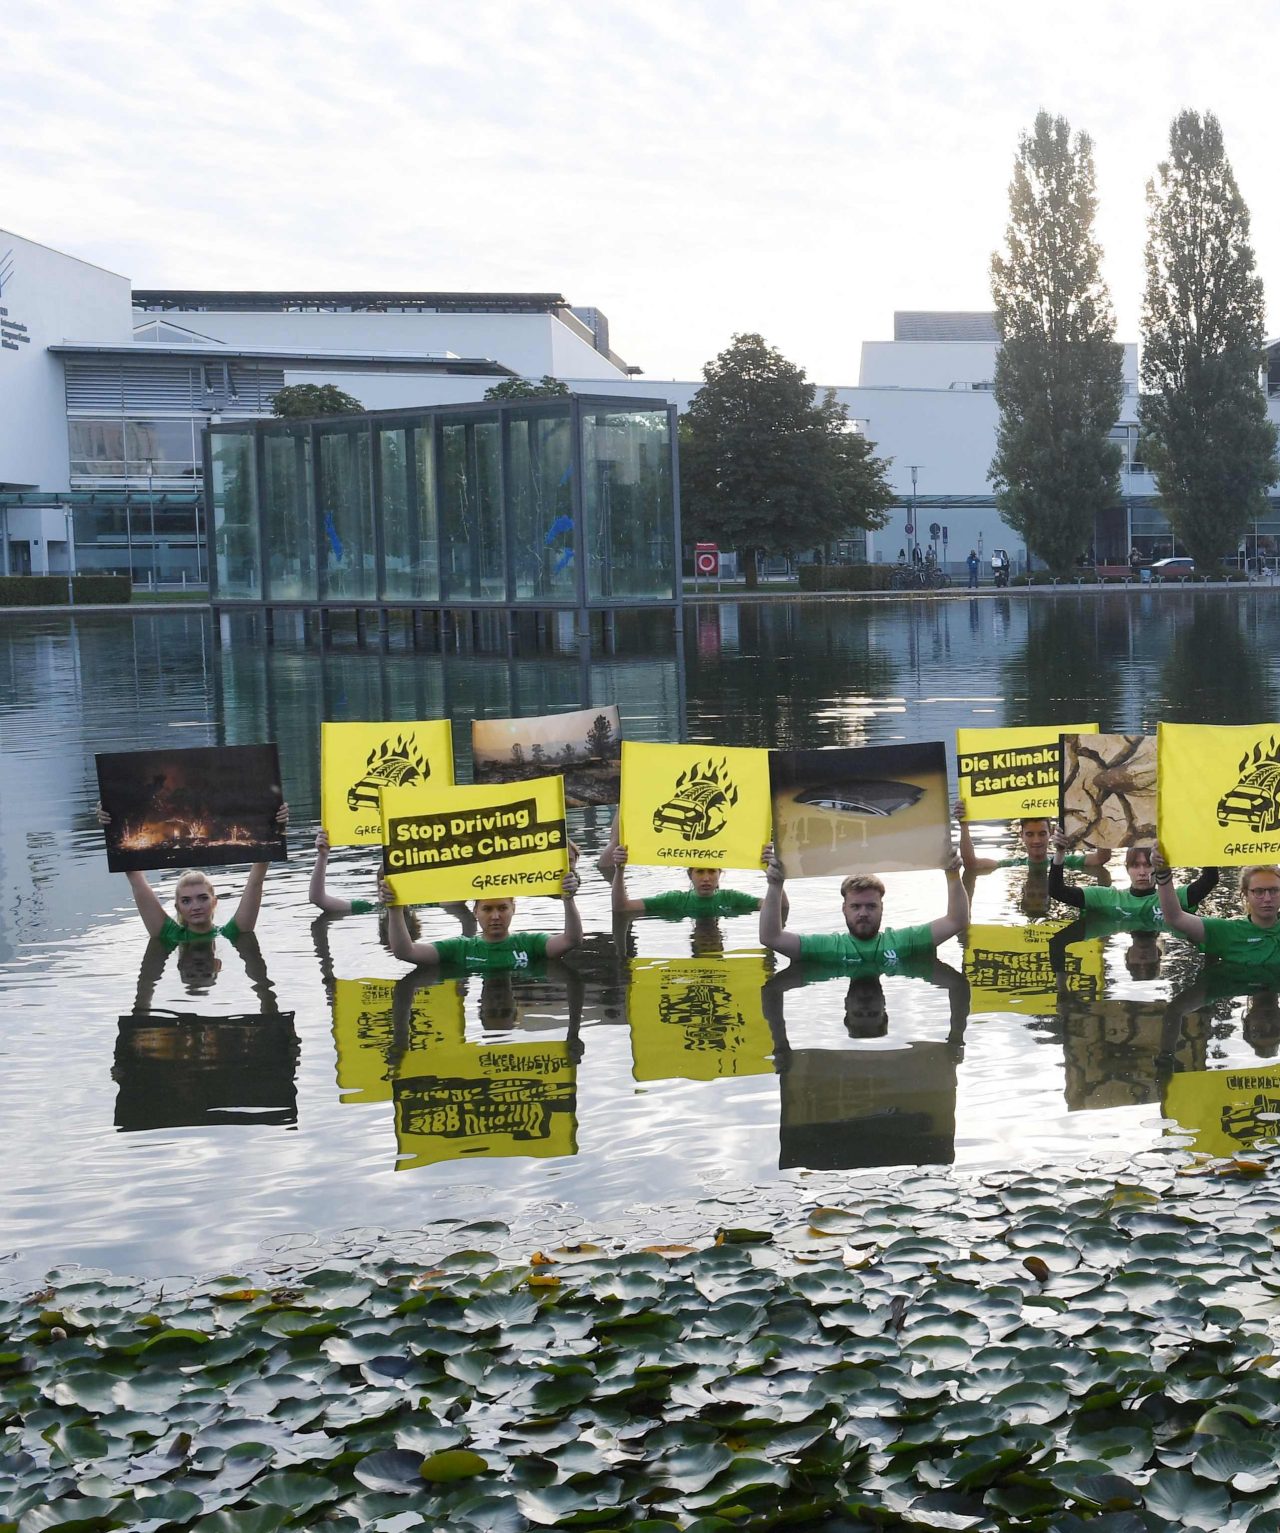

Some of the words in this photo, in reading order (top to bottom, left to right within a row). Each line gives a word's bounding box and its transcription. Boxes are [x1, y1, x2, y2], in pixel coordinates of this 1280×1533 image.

[960, 756, 990, 773] Die
[975, 771, 1034, 792] startet
[396, 822, 446, 842] Stop
[450, 809, 530, 836] Driving
[388, 843, 473, 867] Climate
[477, 829, 561, 855] Change
[656, 847, 727, 859] GREENPEACE
[471, 868, 564, 890] GREENPEACE
